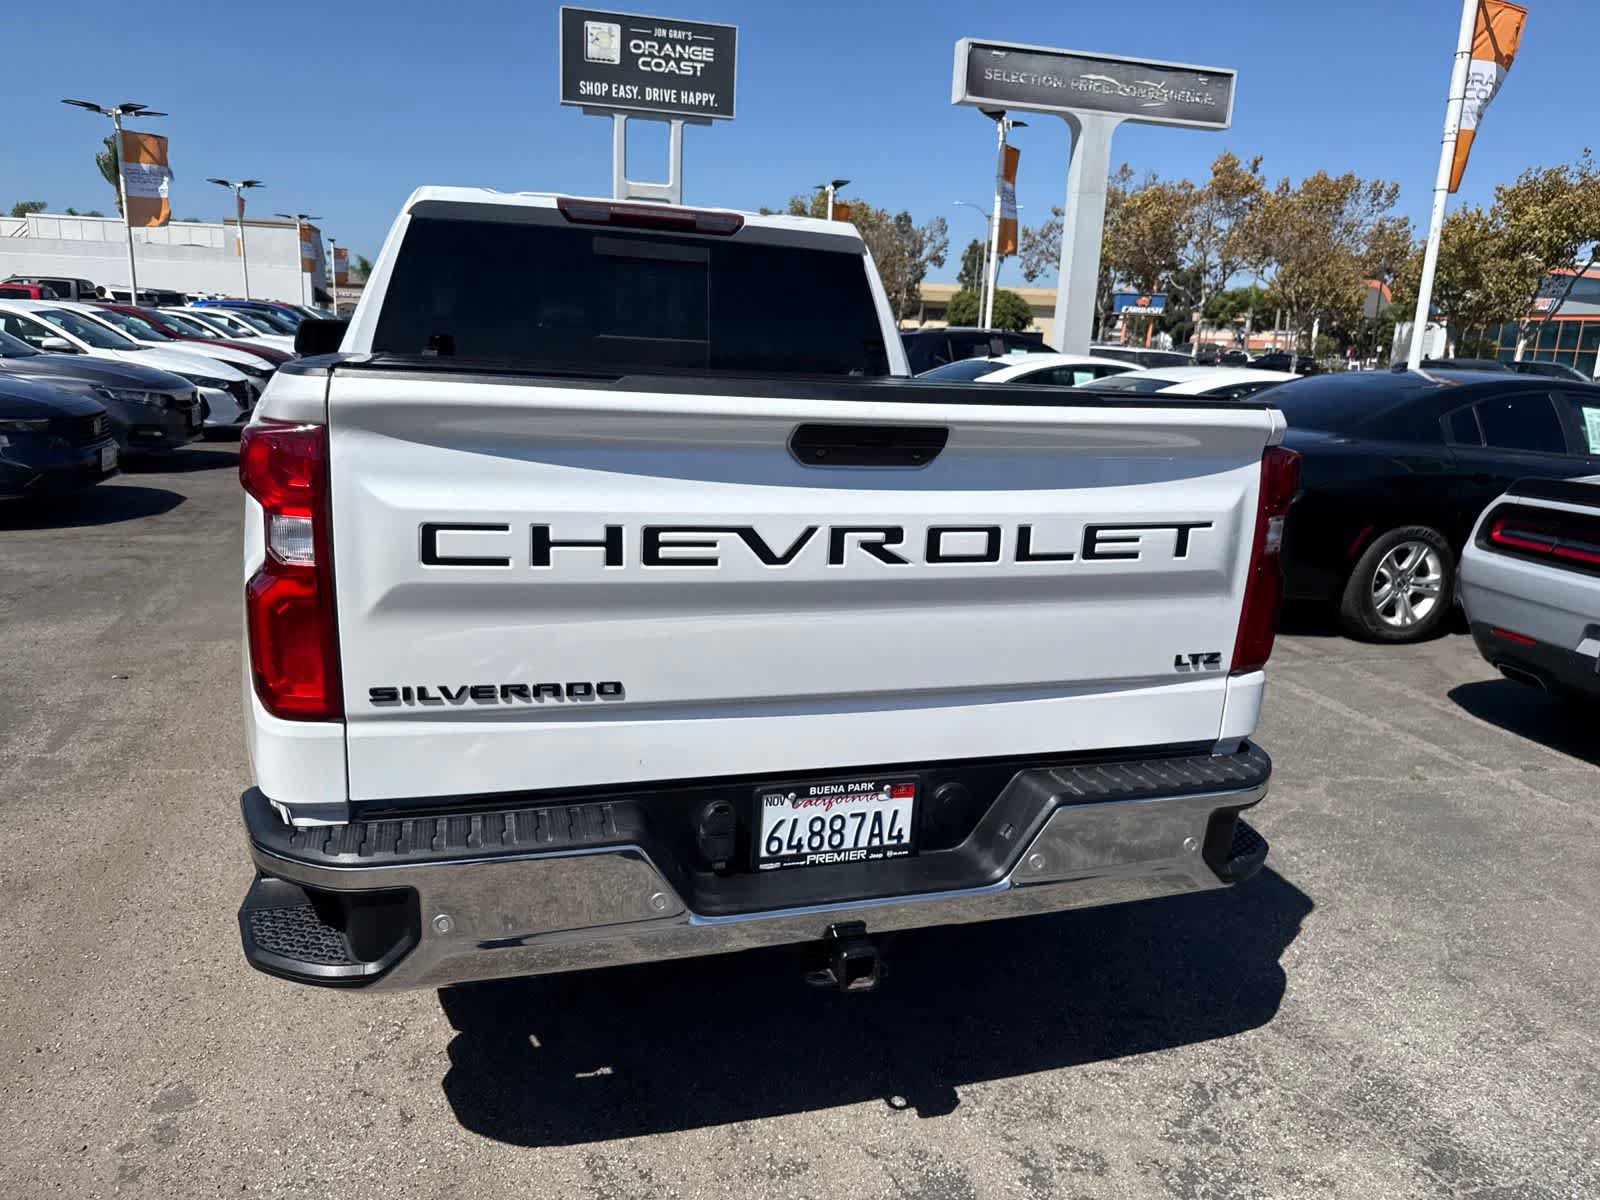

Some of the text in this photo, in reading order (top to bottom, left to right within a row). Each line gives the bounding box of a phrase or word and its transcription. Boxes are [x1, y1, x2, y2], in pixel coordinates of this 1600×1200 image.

[654, 27, 692, 40] JON GRAY'S
[629, 39, 714, 61] ORANGE
[638, 57, 704, 76] COAST
[579, 80, 718, 107] SHOP EASY. DRIVE HAPPY.
[418, 521, 1214, 568] CHEVROLET
[1174, 652, 1221, 668] LTZ
[369, 681, 624, 704] SILVERADO
[809, 782, 875, 796] BUENA PARK
[765, 796, 785, 807] NOV
[765, 809, 904, 855] 64887A4
[806, 850, 867, 864] PREMIER
